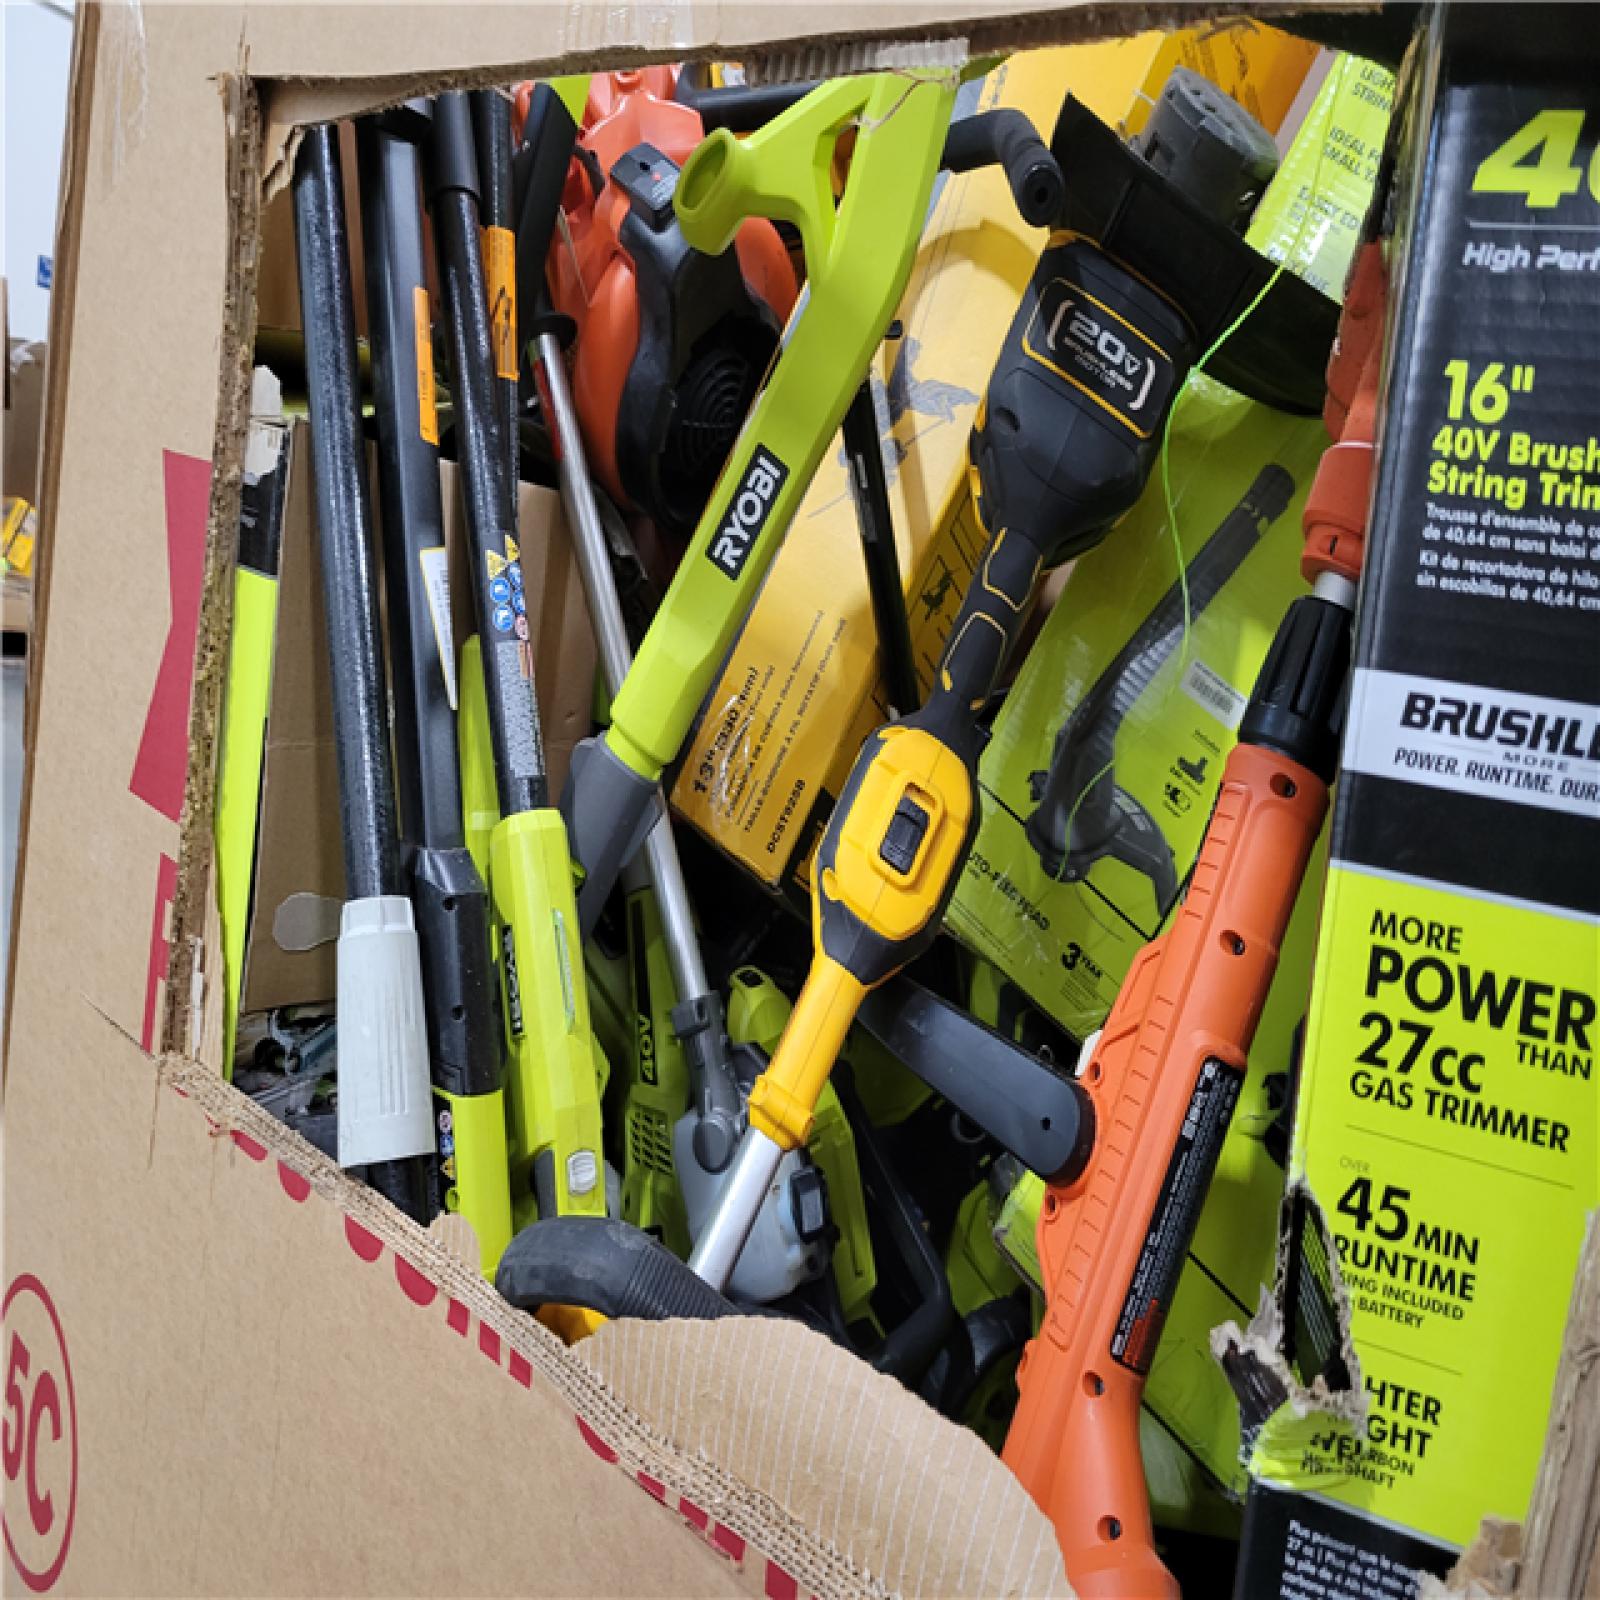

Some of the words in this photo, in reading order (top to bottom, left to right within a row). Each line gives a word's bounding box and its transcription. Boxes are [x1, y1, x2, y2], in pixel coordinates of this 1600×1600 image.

[1472, 109, 1600, 208] 4
[1462, 241, 1531, 273] High
[1444, 359, 1535, 424] 16"
[1432, 425, 1500, 461] 40V
[1427, 459, 1528, 511] String
[713, 454, 782, 569] RYOBI
[1426, 502, 1478, 525] Trousse
[1564, 518, 1585, 538] de
[1422, 522, 1441, 541] de
[1444, 525, 1486, 546] 40,64
[1489, 535, 1511, 549] cm
[1419, 550, 1438, 567] Kit
[1441, 552, 1460, 571] de
[1549, 566, 1568, 585] de
[1416, 569, 1436, 588] sin
[1509, 581, 1529, 601] de
[1532, 585, 1576, 608] 40,64
[1369, 908, 1463, 956] MORE
[1061, 941, 1082, 971] 3
[1365, 943, 1598, 1053] POWER
[1515, 1039, 1592, 1080] THAN
[1350, 1069, 1414, 1110] GAS
[1424, 1087, 1571, 1153] TRIMMER
[1336, 1176, 1411, 1242] 45
[1413, 1221, 1480, 1265] MIN
[1333, 1234, 1476, 1303] RUNTIME
[1358, 1296, 1425, 1329] BATTERY
[1382, 1283, 1465, 1321] INCLUDED
